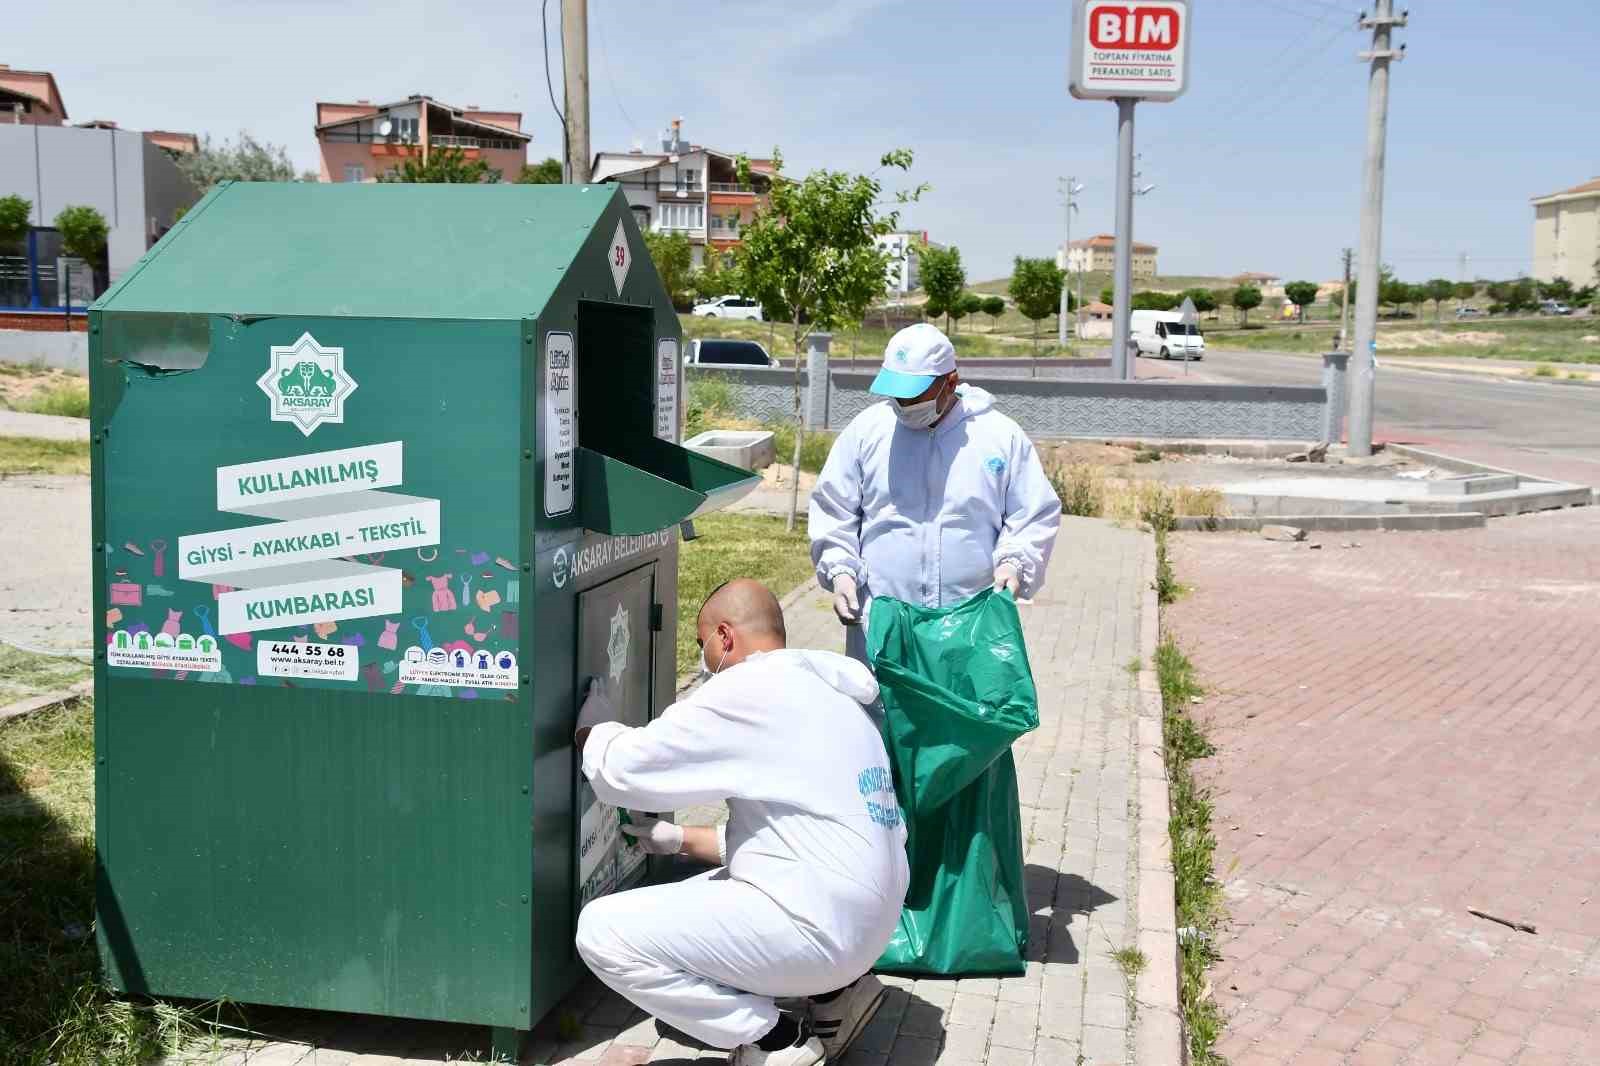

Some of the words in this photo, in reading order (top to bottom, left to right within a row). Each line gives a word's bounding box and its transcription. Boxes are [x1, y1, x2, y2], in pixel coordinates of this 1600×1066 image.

[1093, 52, 1128, 61] TOPTAN
[1092, 67, 1144, 76] PERAKENDE
[615, 245, 625, 267] 39
[282, 398, 332, 407] AKSARAY
[238, 460, 379, 497] KULLANILMIŞ
[187, 542, 234, 566] GİYSİ
[252, 532, 340, 557] AYAKKABI
[360, 517, 426, 543] TEKSTİL
[569, 539, 612, 579] AKSARAY
[246, 588, 375, 620] KUMBARASI
[272, 644, 299, 655] 444
[306, 645, 321, 656] 55
[327, 647, 344, 657] 68
[270, 656, 345, 666] www.aksaray.bel.tr
